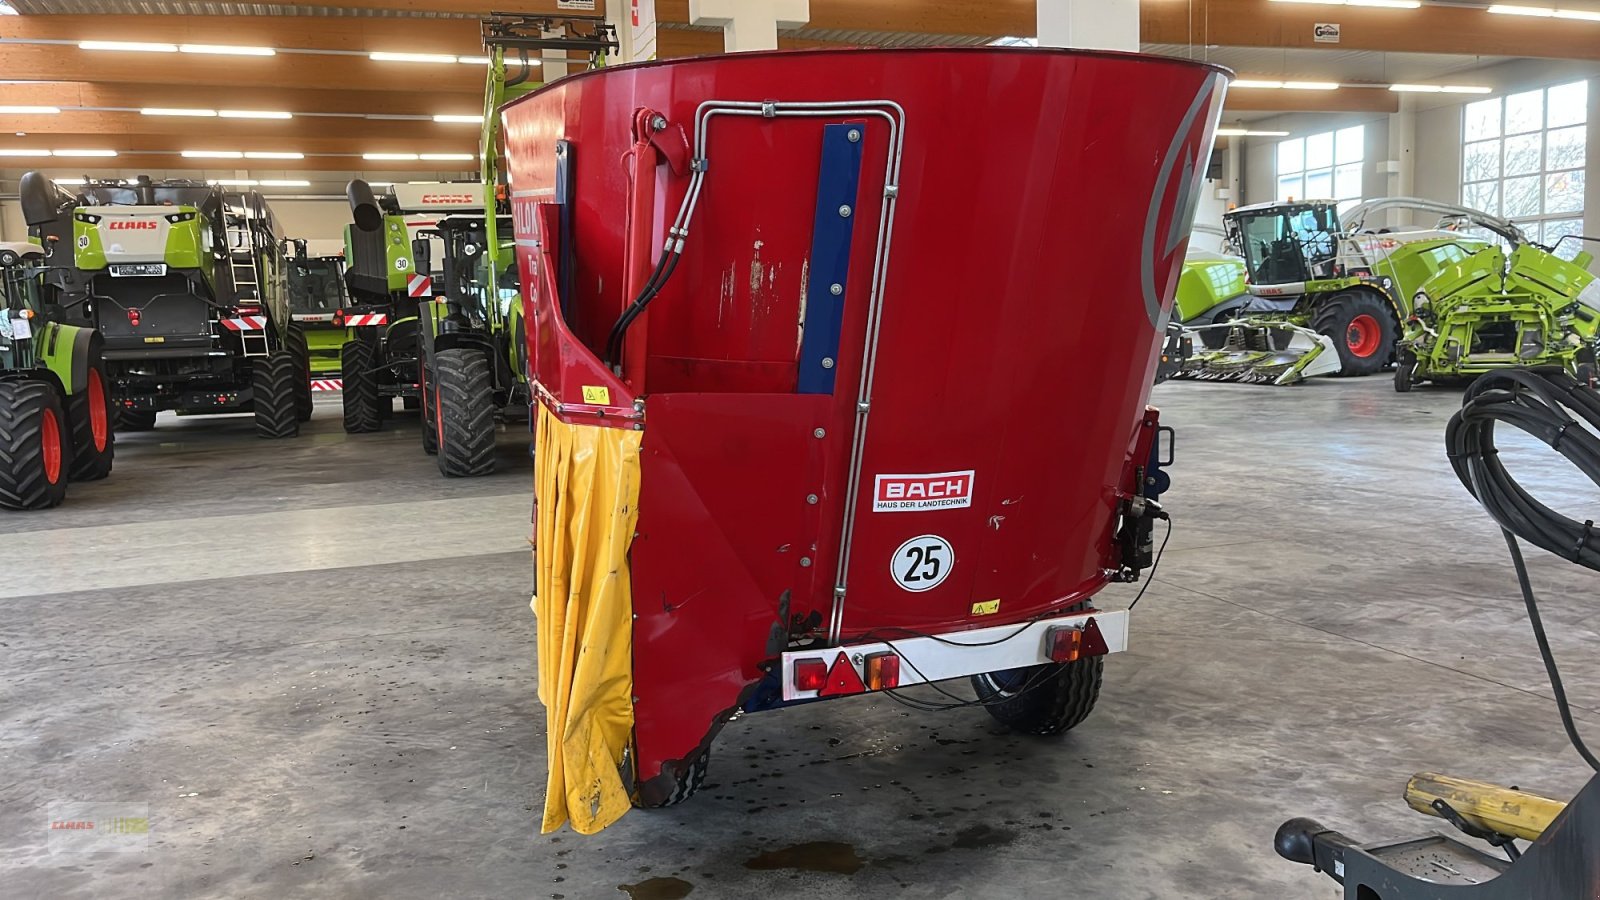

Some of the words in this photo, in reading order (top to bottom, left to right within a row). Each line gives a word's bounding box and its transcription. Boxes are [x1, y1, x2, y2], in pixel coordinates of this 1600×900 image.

[422, 194, 473, 204] CLAAS
[109, 221, 158, 230] CLAAS
[79, 236, 88, 248] 30
[397, 259, 407, 269] 30
[886, 479, 963, 498] BACH
[877, 501, 898, 509] HAUS
[918, 498, 968, 508] LANDTECHNIK
[904, 545, 942, 582] 25
